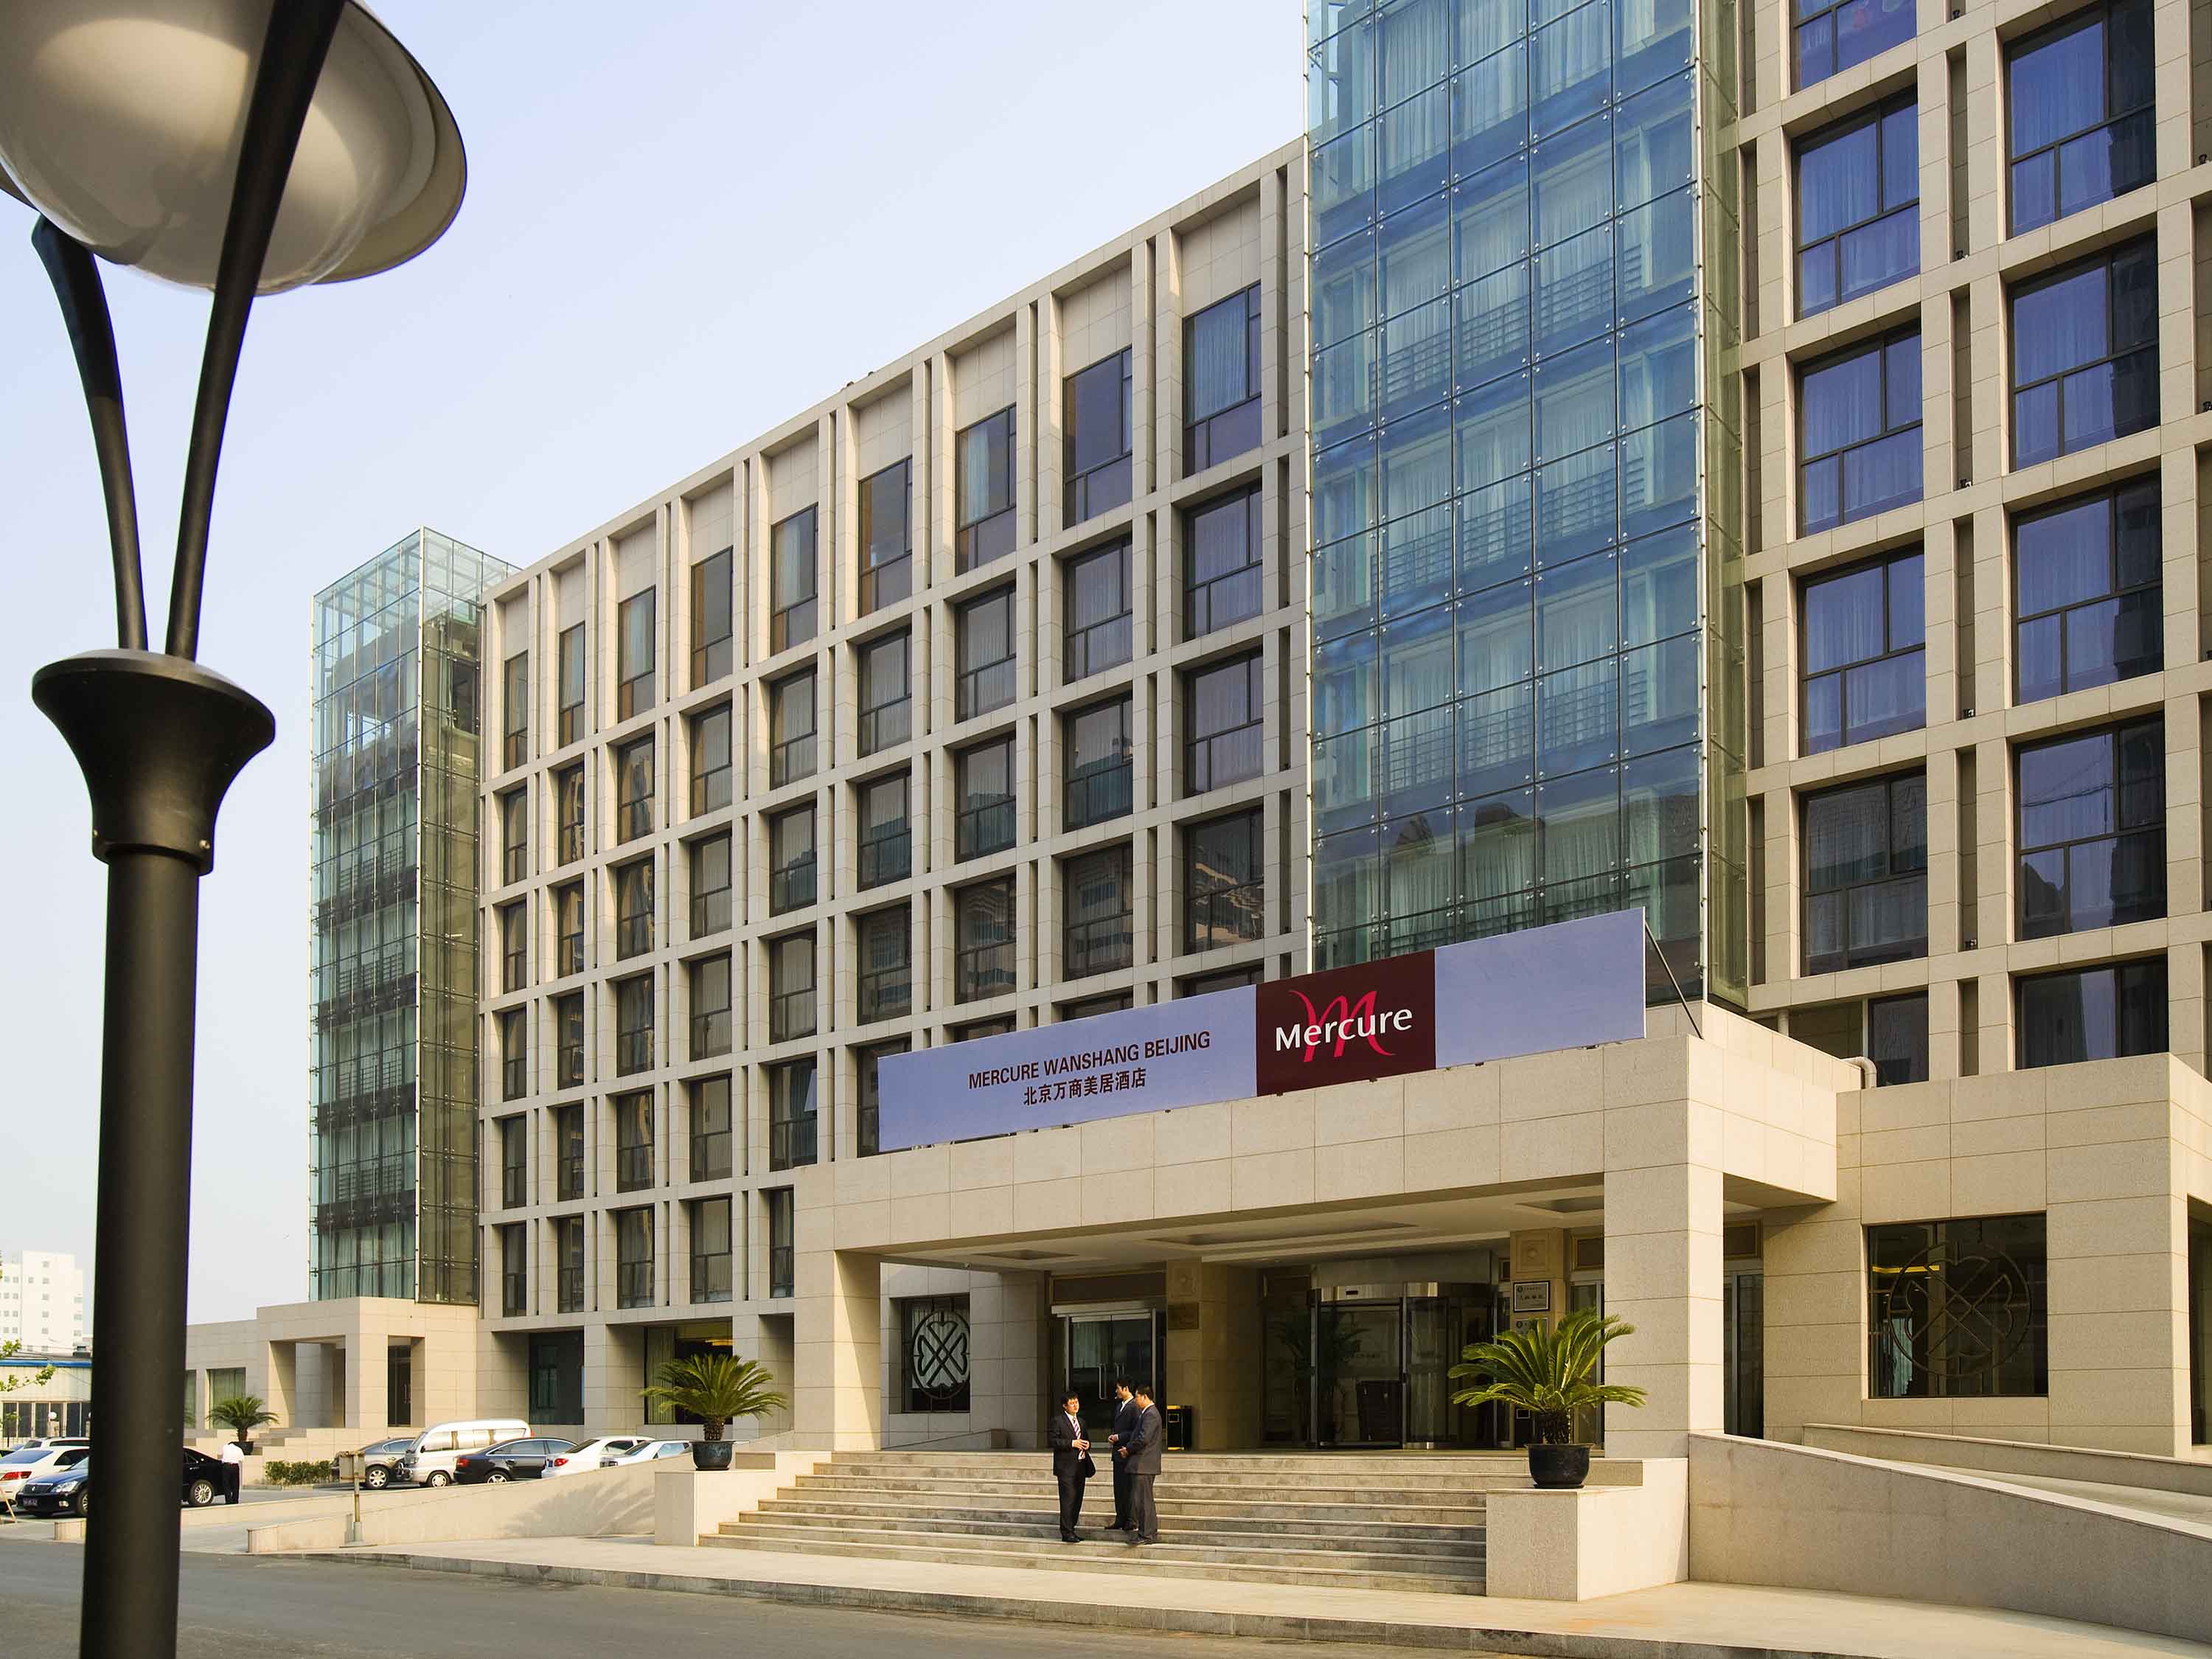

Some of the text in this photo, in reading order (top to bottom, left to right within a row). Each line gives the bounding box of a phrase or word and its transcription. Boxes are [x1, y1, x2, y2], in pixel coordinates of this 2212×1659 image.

[1276, 1008, 1413, 1051] Mercure
[968, 1030, 1210, 1090] MERCURE WANSHANG BEIJING
[1023, 1067, 1147, 1107] 北京万商美居酒店
